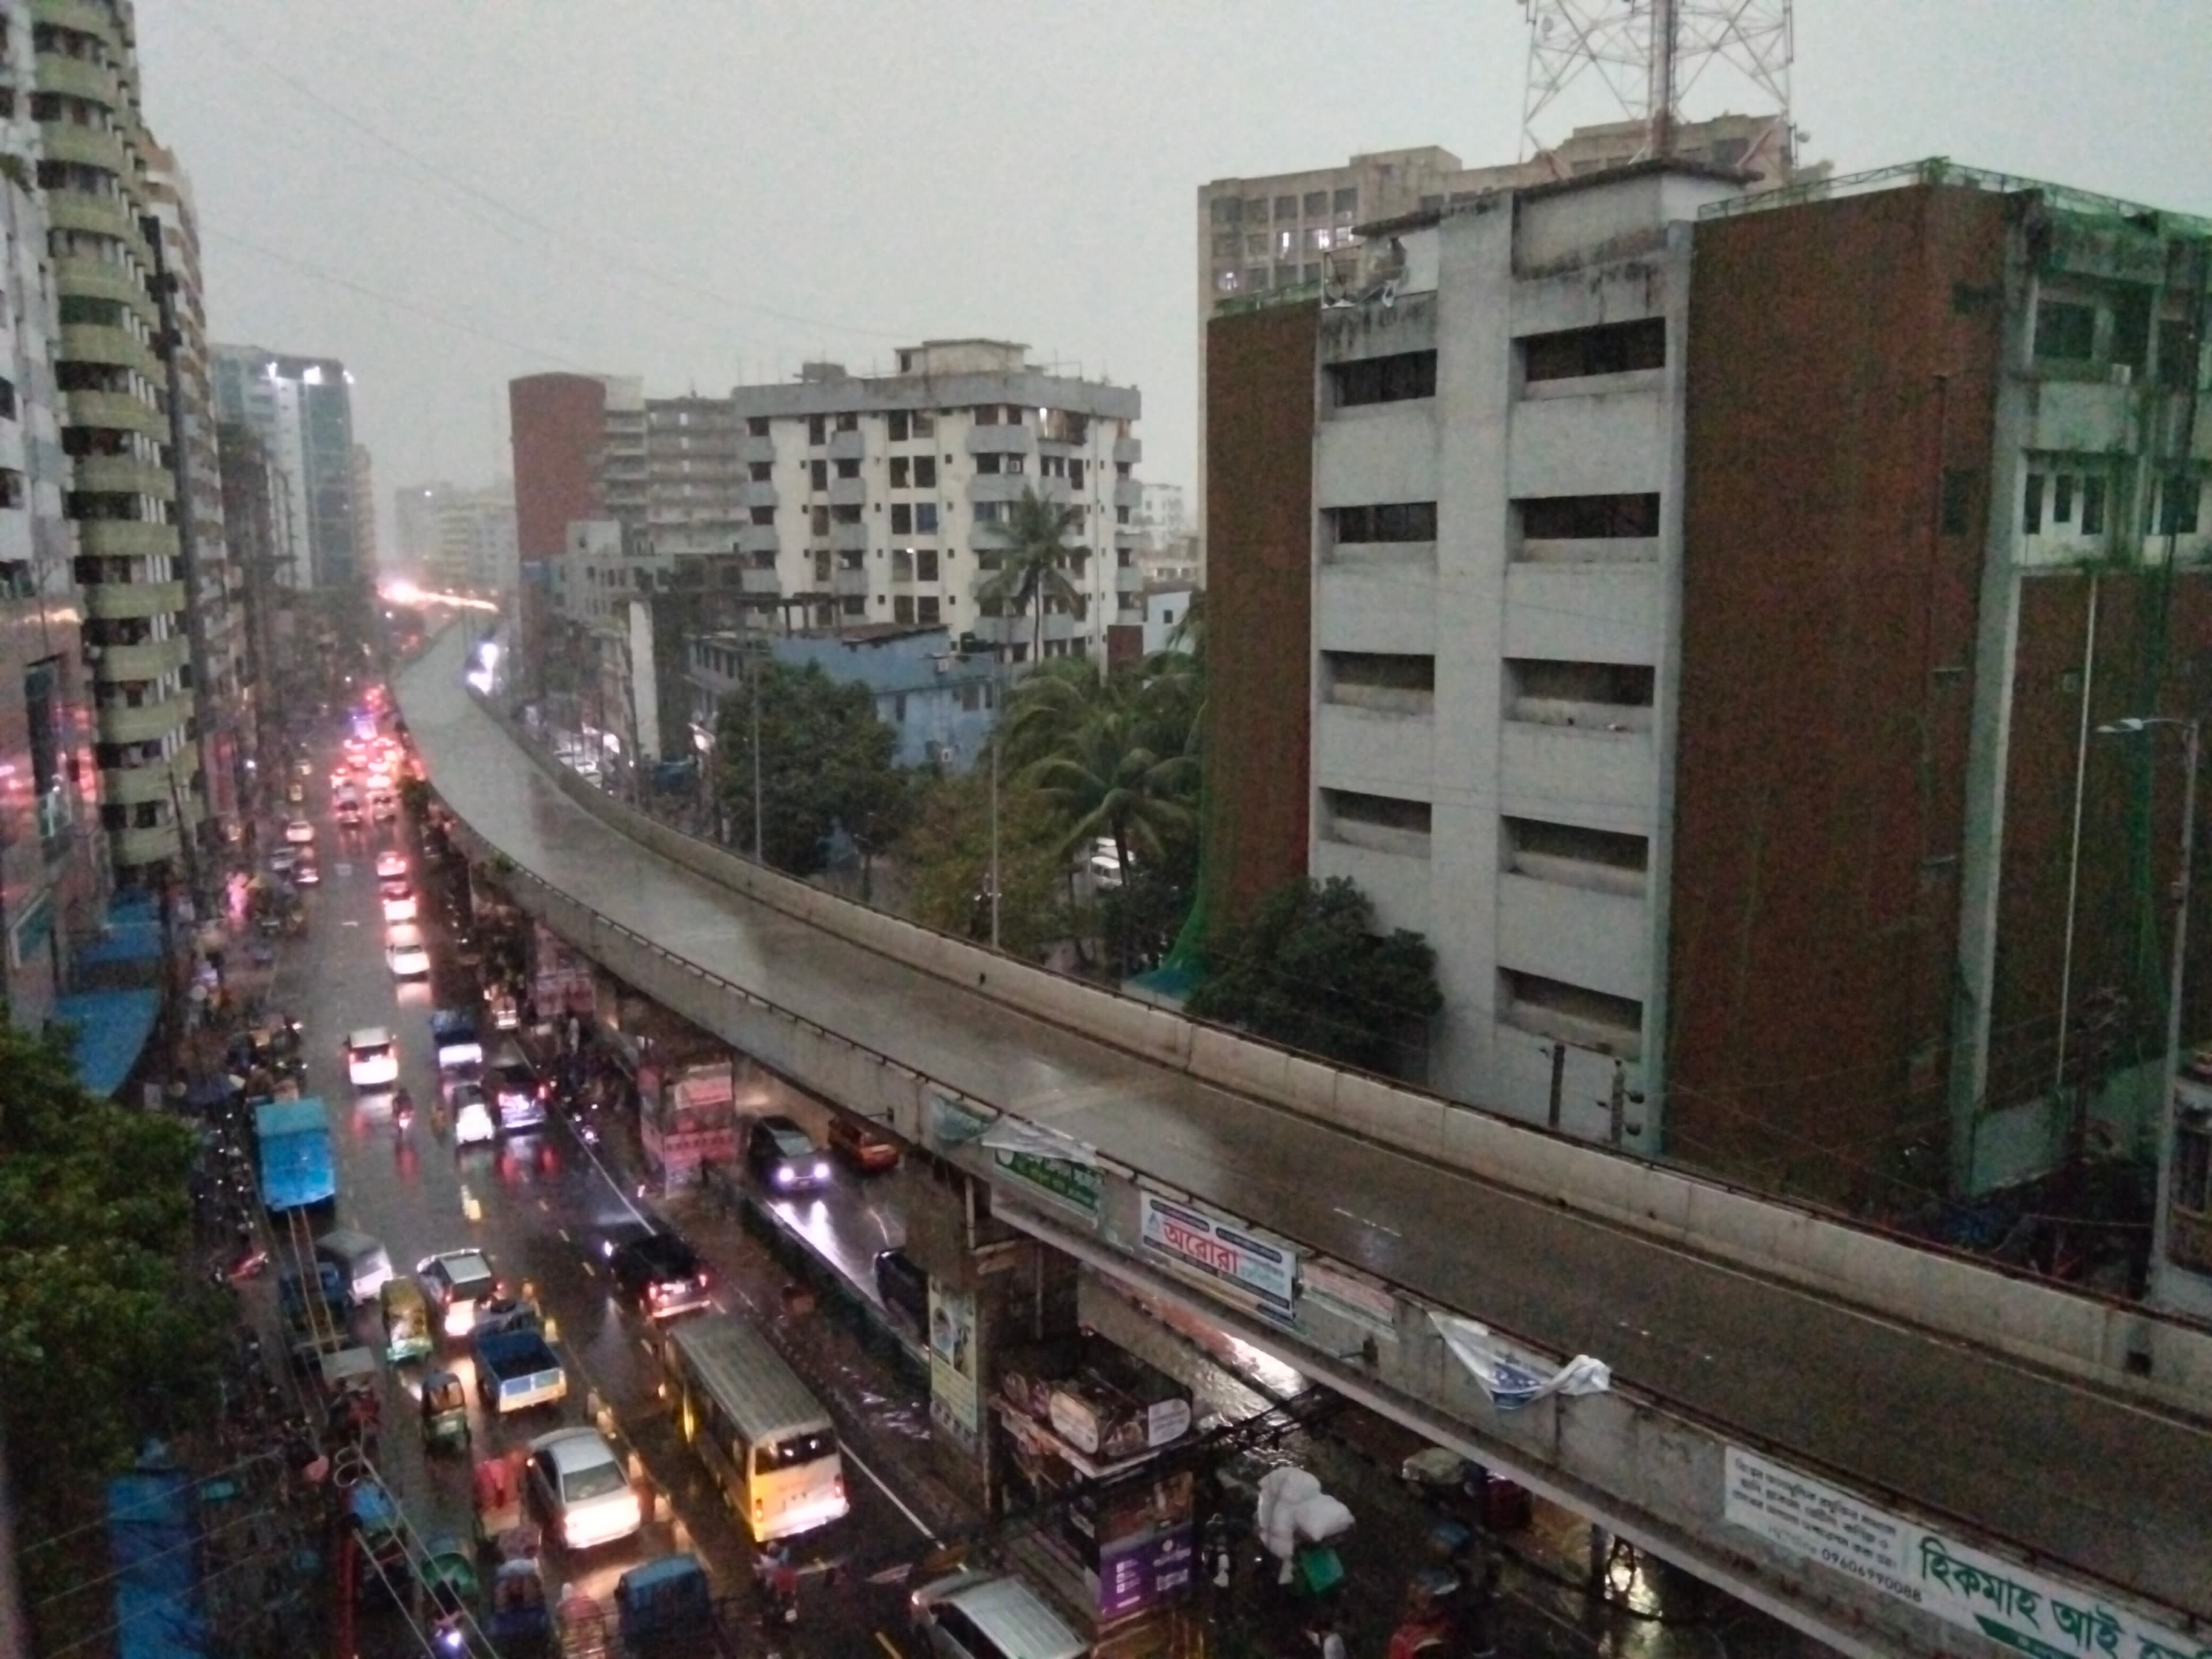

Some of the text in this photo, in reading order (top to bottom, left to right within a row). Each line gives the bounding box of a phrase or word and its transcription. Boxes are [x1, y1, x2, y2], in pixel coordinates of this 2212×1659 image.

[1163, 1222, 1238, 1274] অরোরা
[1821, 1548, 1922, 1603] 09606990088
[1918, 1535, 2126, 1659] হিকমাহ আই
